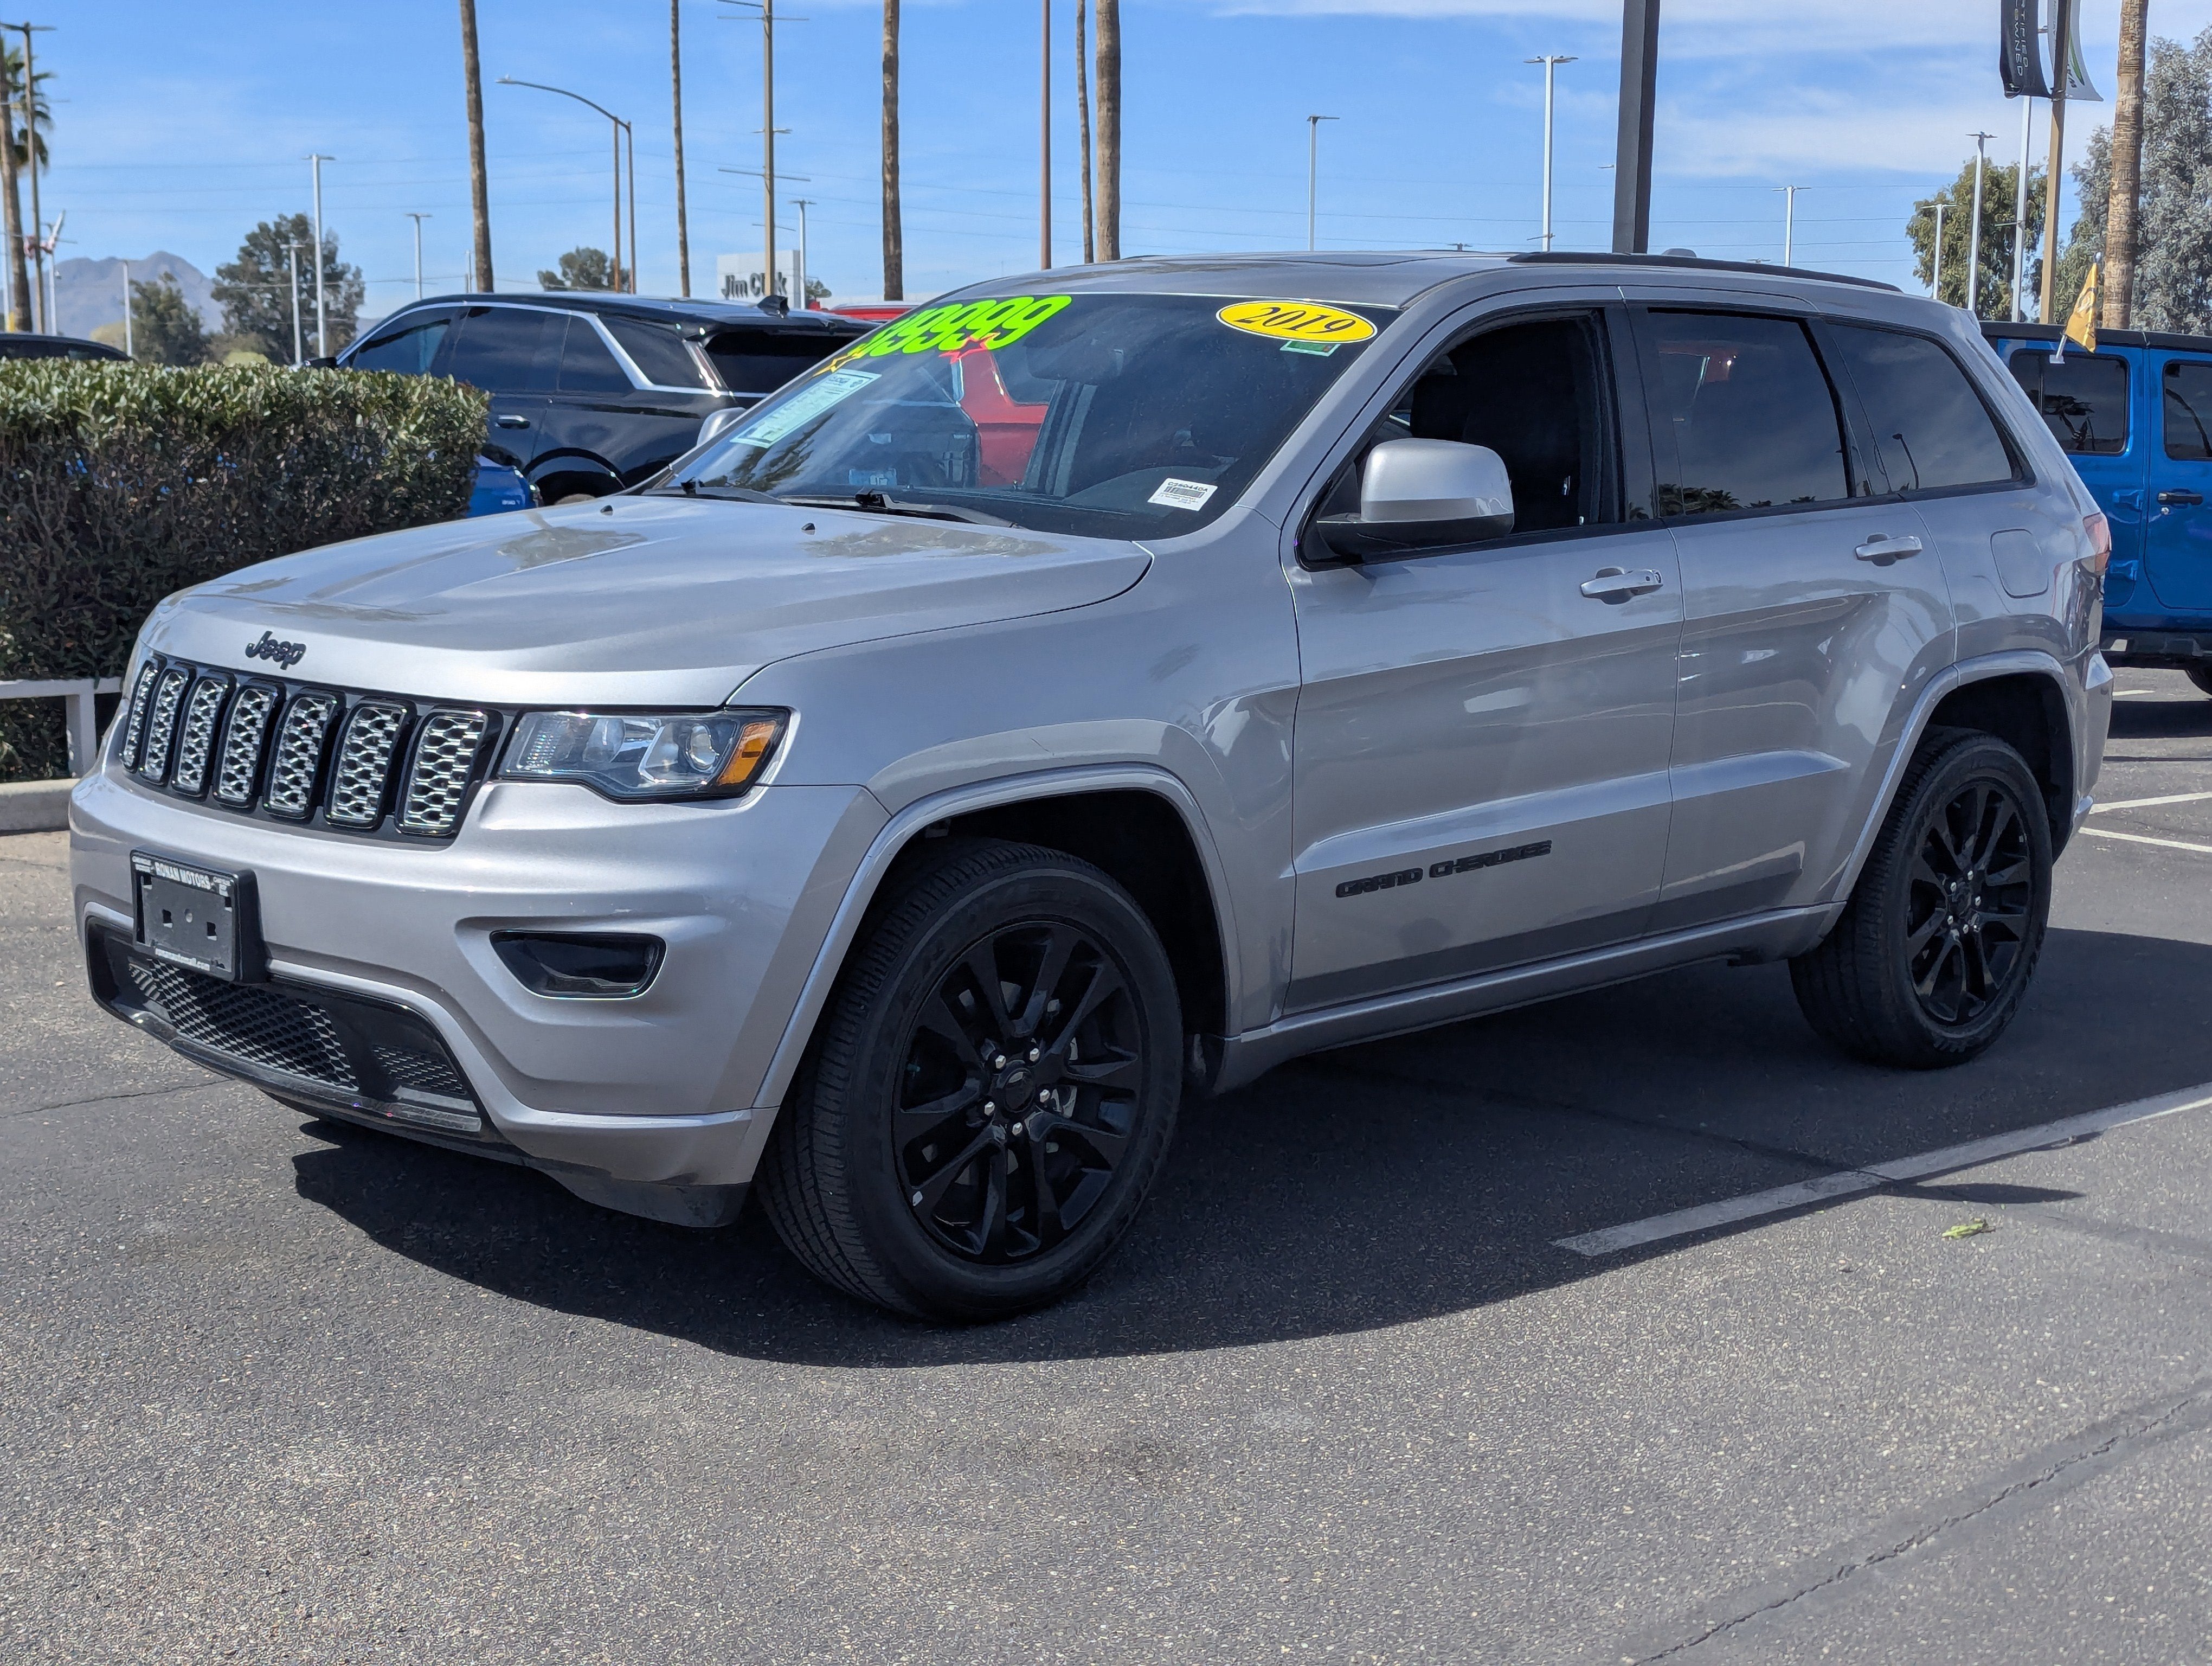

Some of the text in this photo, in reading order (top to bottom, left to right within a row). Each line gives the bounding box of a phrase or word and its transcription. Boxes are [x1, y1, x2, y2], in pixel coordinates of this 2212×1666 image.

[721, 272, 787, 299] Jim Clk
[1233, 306, 1356, 334] 2019
[245, 630, 307, 670] Jeep
